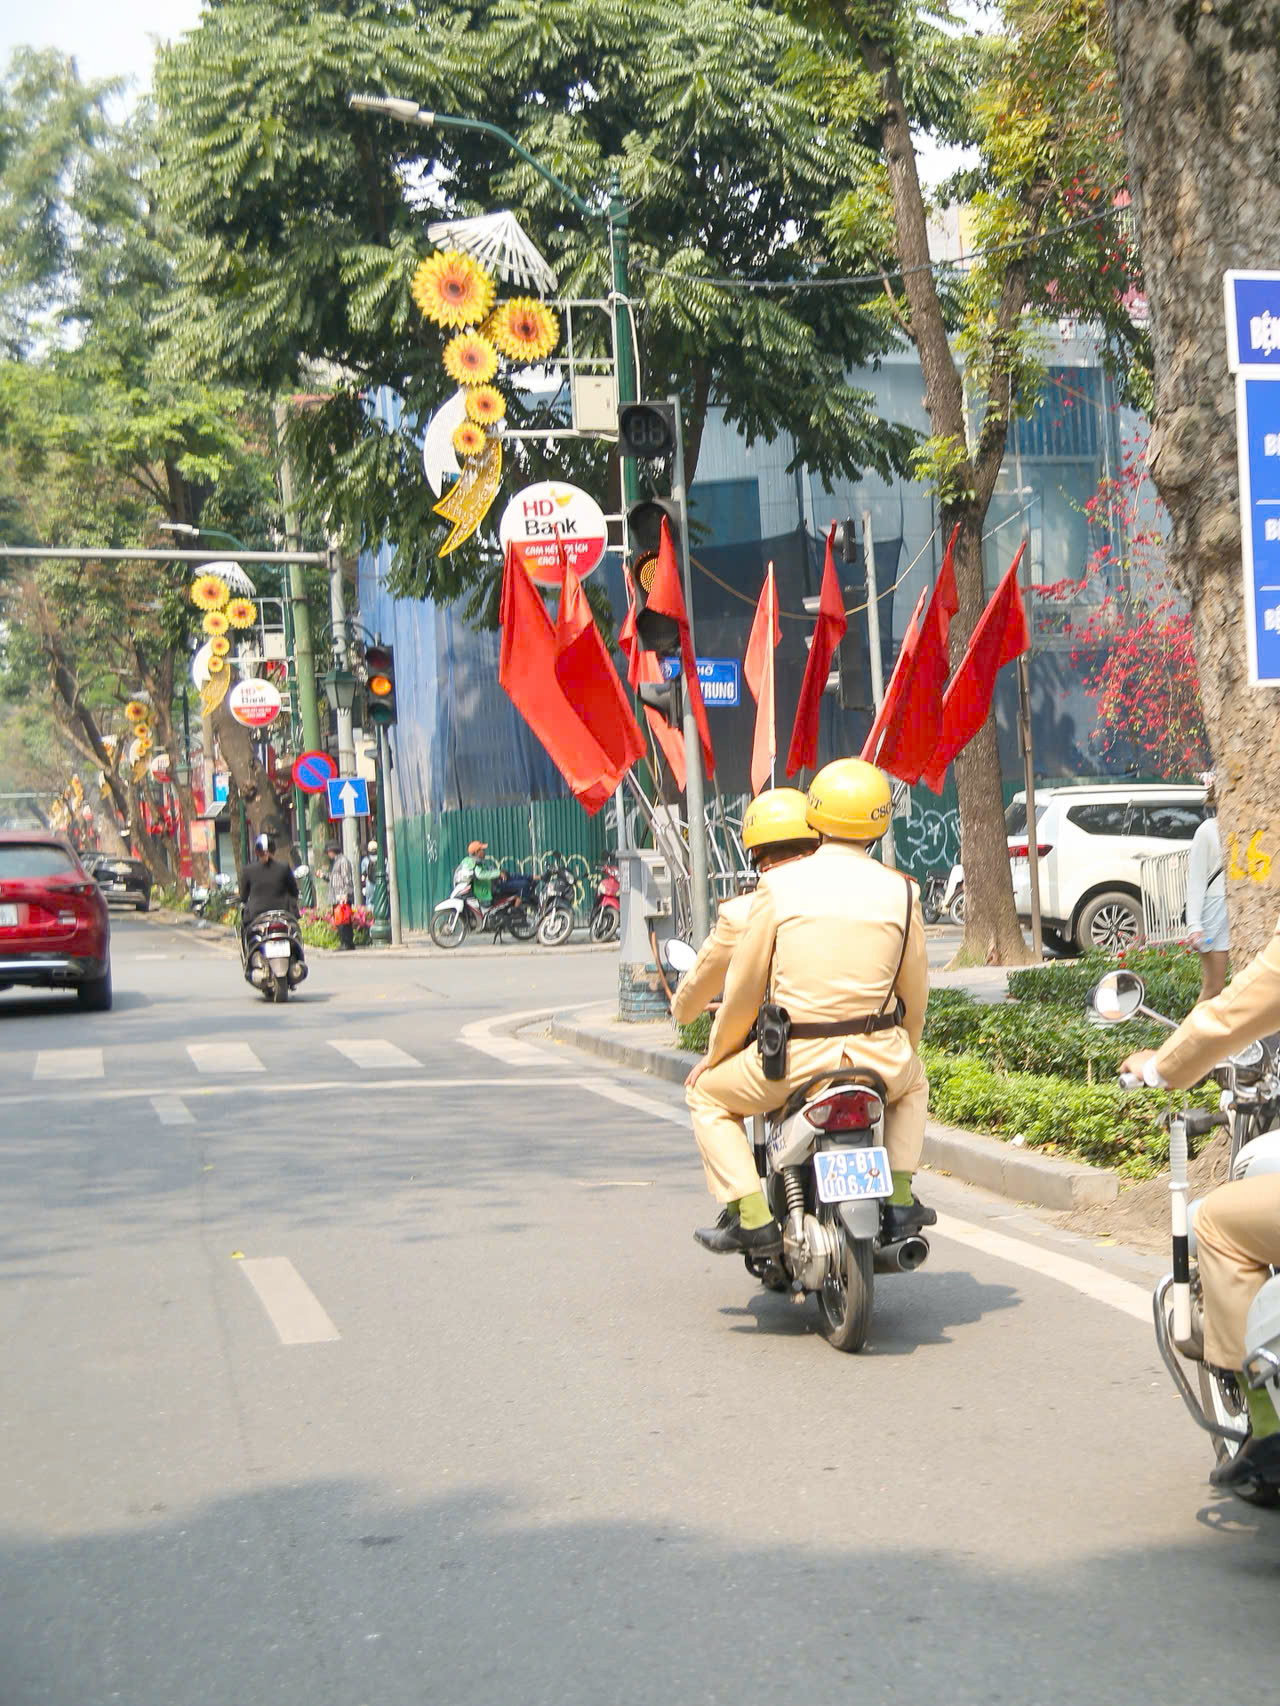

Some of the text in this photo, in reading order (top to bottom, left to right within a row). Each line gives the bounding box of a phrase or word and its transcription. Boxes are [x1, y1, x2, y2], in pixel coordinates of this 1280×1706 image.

[523, 499, 554, 517] HD
[525, 518, 577, 536] Bank
[696, 663, 714, 676] HỐ
